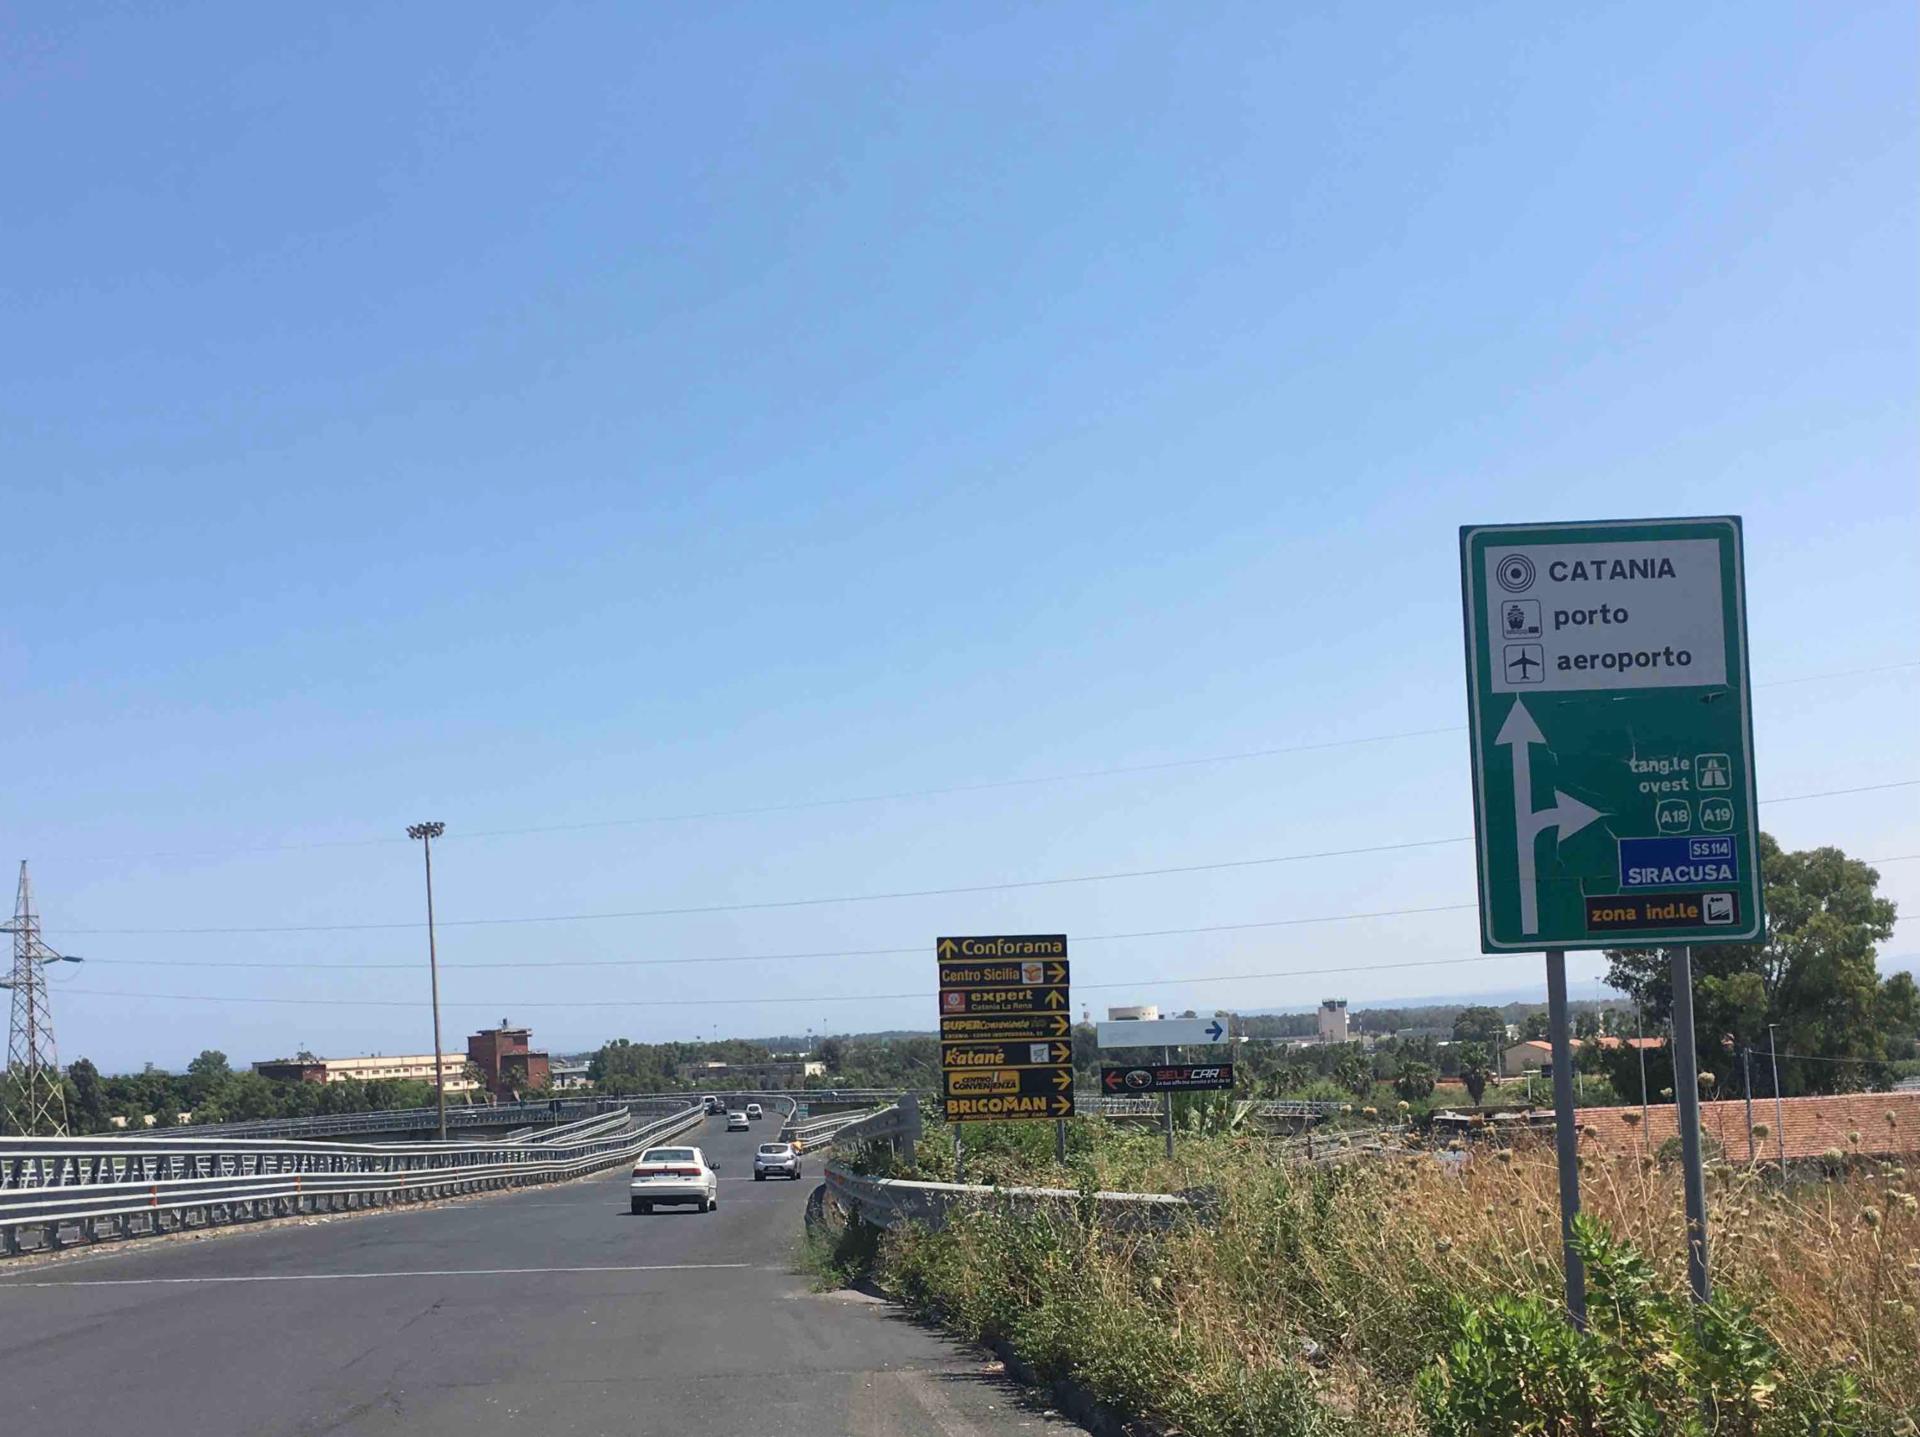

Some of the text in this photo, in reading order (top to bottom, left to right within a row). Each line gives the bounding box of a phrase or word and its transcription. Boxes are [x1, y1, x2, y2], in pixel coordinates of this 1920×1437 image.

[1549, 558, 1676, 582] CATANIA
[1554, 604, 1629, 630] porto
[1557, 646, 1692, 673] aeroporto
[1631, 757, 1690, 774] tang.le
[1639, 777, 1689, 793] ovest
[1661, 808, 1731, 824] A18 A19
[1628, 864, 1732, 884] SIRACUSA
[1592, 903, 1698, 922] zona ind.le
[962, 938, 1063, 955] Conforama
[942, 967, 1020, 982] Centro Sicilia
[971, 989, 1033, 1003] expert
[945, 1047, 1005, 1065] Katané
[947, 1096, 1047, 1114] BRICOMAN
